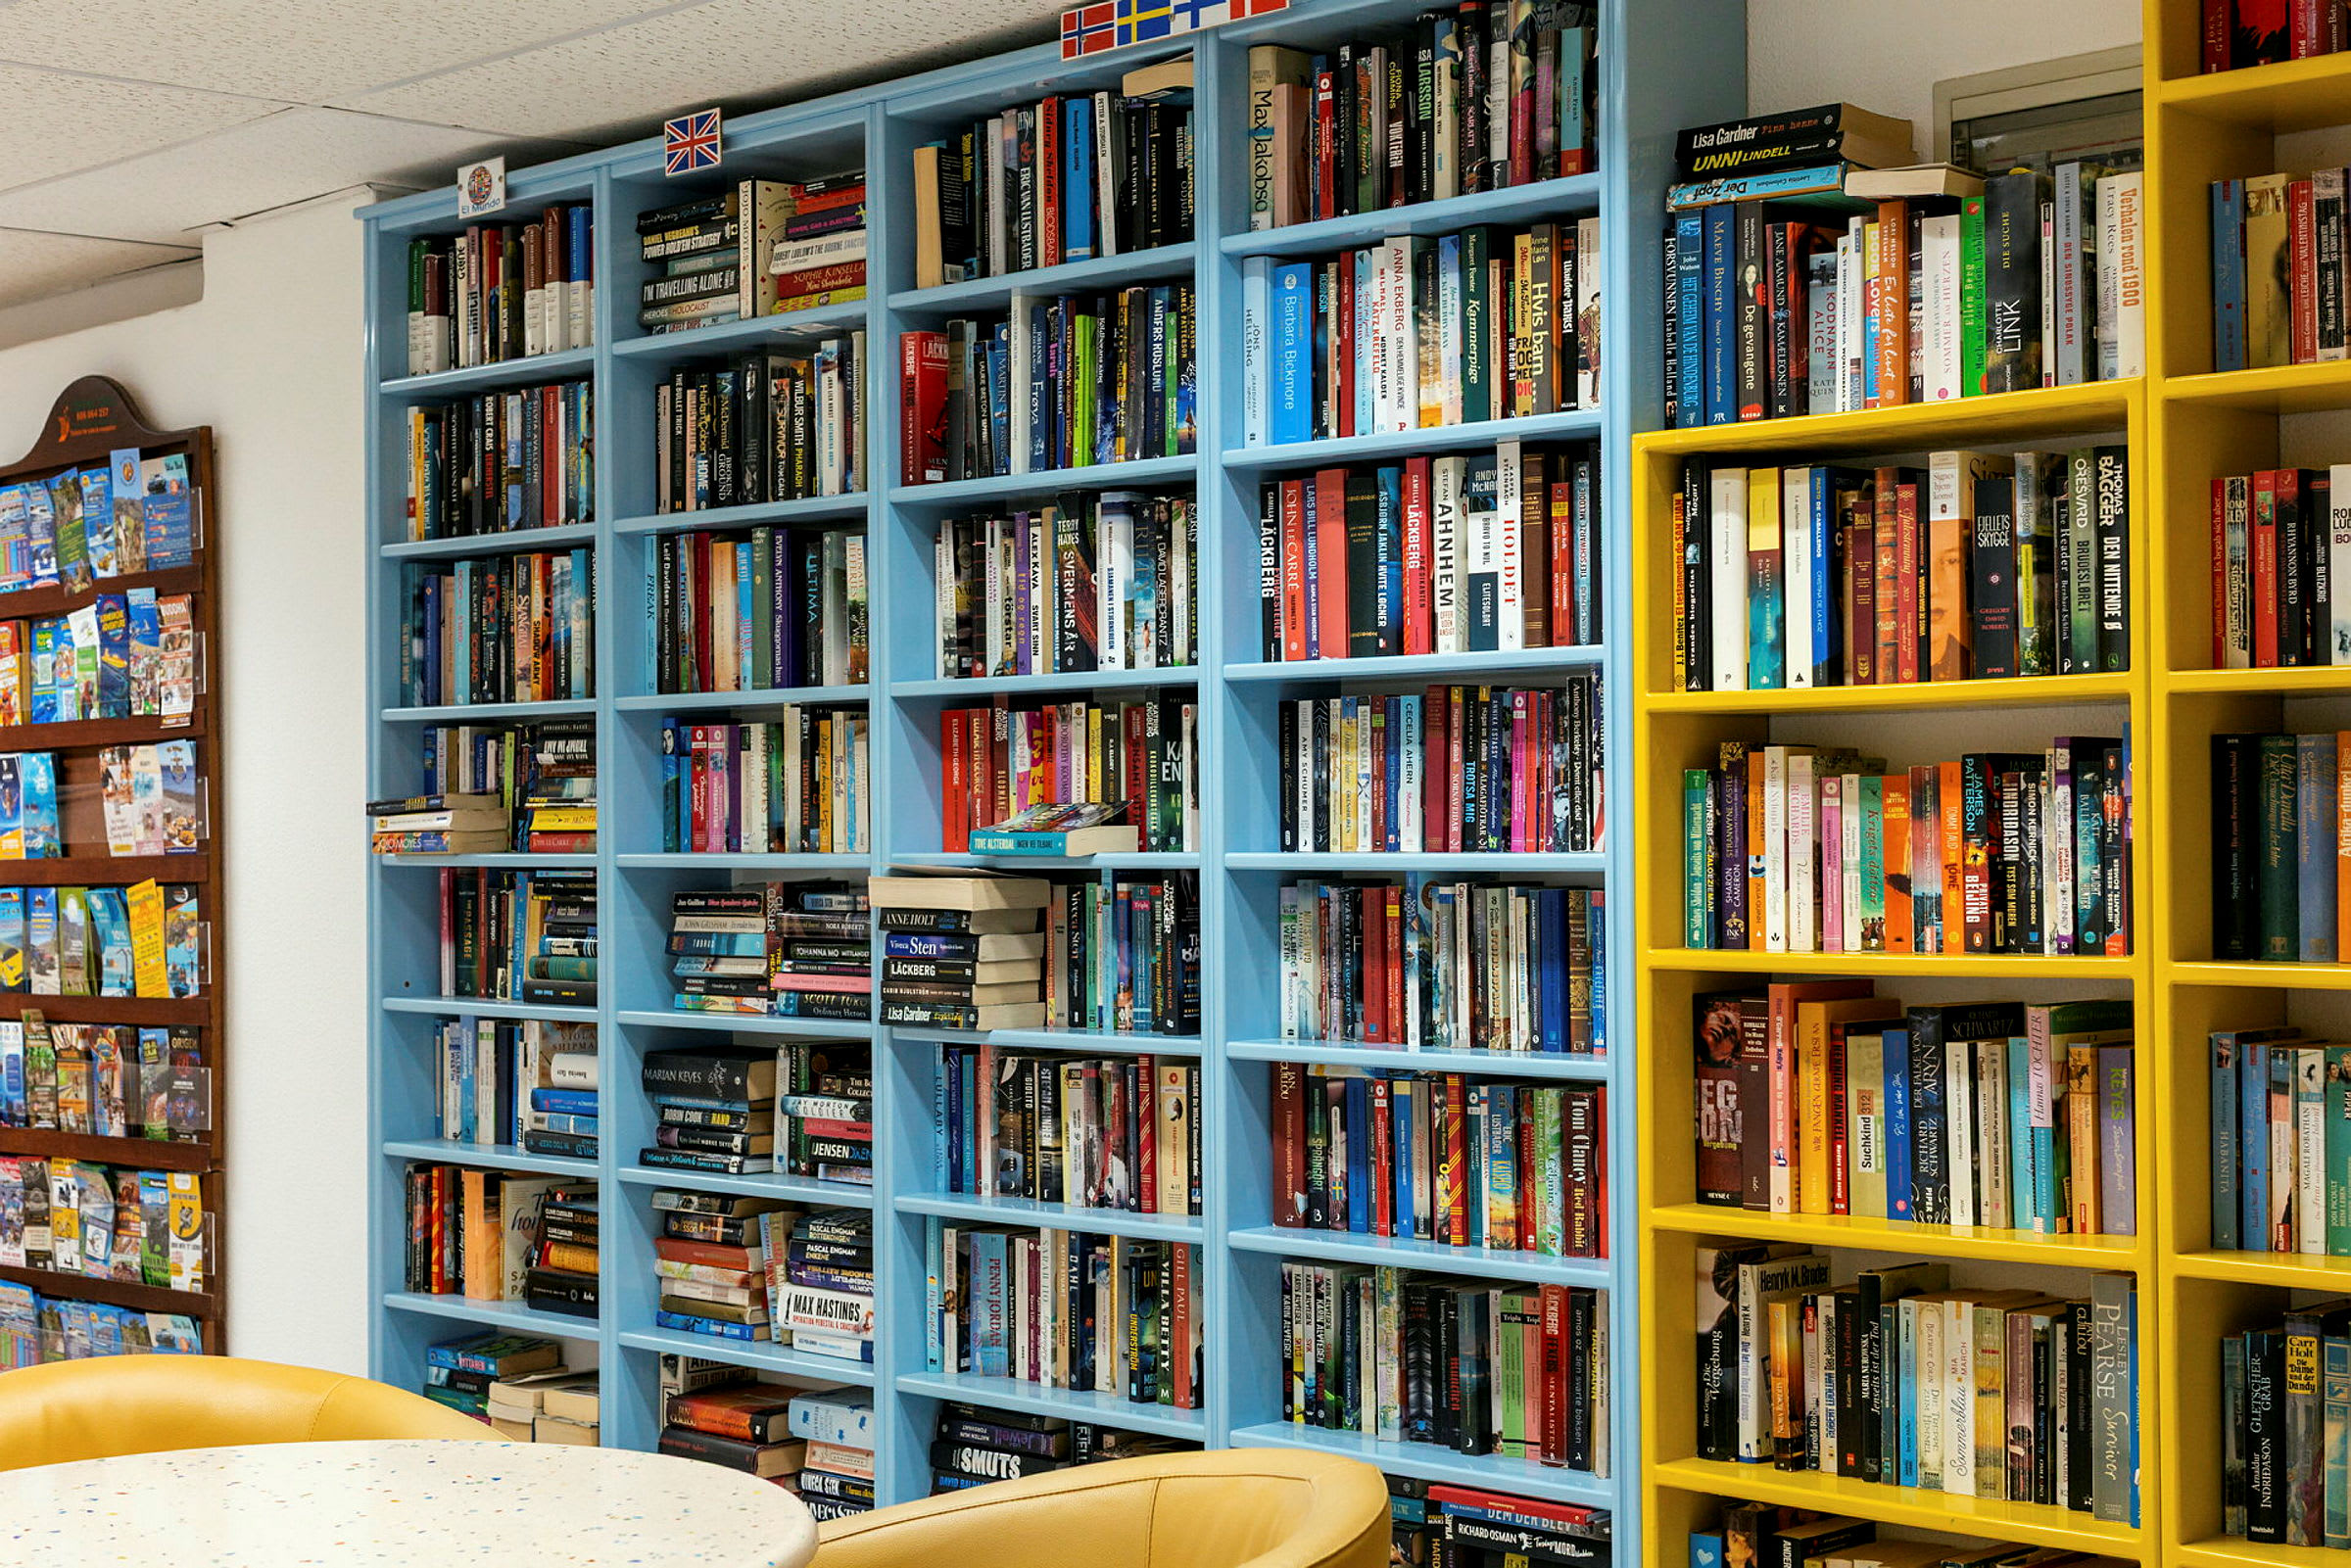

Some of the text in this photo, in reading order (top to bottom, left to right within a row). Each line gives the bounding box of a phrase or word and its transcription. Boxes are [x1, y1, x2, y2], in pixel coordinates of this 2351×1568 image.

[1418, 62, 1432, 120] LARSSON
[1254, 90, 1272, 213] Max Jakobso
[1693, 124, 1758, 149] Lisa Gardner
[1693, 146, 1791, 172] UNNI LINDELL
[470, 198, 501, 213] Mundo
[1693, 181, 1748, 201] Der Zopf
[1713, 221, 1725, 312] MAEVE BINCHY
[2001, 211, 2011, 269] DIE SUCHE
[2120, 187, 2140, 308] Verhalen rond 1900
[644, 274, 723, 302] I'M TRAVELLING ALONE
[793, 263, 865, 284] SOPHIE KINSELLA
[1394, 248, 1405, 332] ANNA EKBERG
[1774, 231, 1787, 306] JANE AAMUND
[1532, 282, 1549, 377] Hvis barn
[1664, 238, 1677, 397] FORSVUNNEN Isabelle Holland
[1826, 293, 1837, 370] KODNAMN
[1869, 278, 1883, 332] Lovers
[2002, 299, 2022, 353] LINK
[1285, 296, 1297, 410] Barbara Bickmore
[1466, 299, 1481, 384] Kammerpige
[1743, 306, 1756, 390] De gevangene
[1814, 309, 1825, 355] ALICE
[1776, 322, 1788, 397] KAMÆLEONEN
[795, 380, 804, 415] WILBUR
[794, 417, 804, 446] SMITH
[698, 459, 708, 491] HOME
[2113, 462, 2124, 515] THOMAS
[1057, 518, 1080, 533] TERRY
[1058, 532, 1080, 546] HAYES
[1285, 489, 1300, 593] JOHN LE CARRÉ
[1306, 485, 1318, 580] LARS BILL LUNDHOLM
[1407, 503, 1422, 570] LÄCKBERG
[1675, 499, 1684, 541] SAN JUAN
[1978, 514, 2010, 533] FJELLETS
[1978, 531, 2010, 547] SKYGGE
[2059, 506, 2071, 572] The Reader
[2098, 455, 2123, 631] BAGGER DEN NITTENDE Ø
[1261, 518, 1276, 598] LÄCKBERG
[1437, 502, 1454, 608] AHNHEM
[1504, 519, 1516, 608] HOLDET
[2077, 540, 2090, 613] BRUDESLØRET
[2286, 522, 2299, 605] RHYANNON BYRD
[806, 555, 818, 624] ULTIMA
[1063, 550, 1079, 652] SVERMENS ÅR
[1405, 749, 1414, 784] AHERN
[1964, 758, 1976, 832] PATTERSON
[1974, 773, 1984, 817] JAMES
[1865, 809, 1881, 857] Krigets
[2027, 783, 2038, 863] SIMON KERNICK
[883, 913, 936, 927] ANNE HOLT
[1964, 875, 1981, 924] BEIJING
[1979, 882, 1989, 915] PRIVATE
[891, 962, 936, 976] LÄCKBERG
[909, 936, 936, 955] Sten
[804, 994, 838, 1006] SCOTT
[888, 1007, 932, 1022] Lisa Gardner
[644, 1068, 701, 1084] MARIAN KEYES
[1833, 1045, 1845, 1140] HENNING MANKELL
[1922, 1044, 1942, 1095] ARYN
[2111, 1068, 2124, 1120] KEYES
[813, 1142, 850, 1160] JENSEN
[1861, 1095, 1872, 1168] Suchkind 312
[1919, 1120, 1928, 1173] RICHARD
[1929, 1117, 1938, 1177] SCHWARTZ
[1493, 1161, 1511, 1191] KAISHO
[1568, 1097, 1590, 1249] Tom Clancy Red Rabbit
[1070, 1255, 1079, 1292] DAHL
[1760, 1263, 1829, 1293] Henryk M. Broder
[793, 1295, 861, 1322] MAX HASTINGS
[989, 1258, 1002, 1347] PENNY JORDAN
[1160, 1260, 1171, 1372] VILLA BETTY
[1176, 1285, 1186, 1321] PAUL
[2077, 1307, 2087, 1354] GUILLOU
[2117, 1326, 2127, 1377] LESLEY
[2096, 1303, 2128, 1480] PEARSE Survivor
[2250, 1353, 2262, 1433] GLETSCHER-
[2261, 1377, 2272, 1410] GRAB
[1950, 1384, 1968, 1476] Sommerblau
[960, 1447, 1021, 1480] SMUTS
[2261, 1438, 2272, 1508] INDRIÐASON
[1458, 1523, 1517, 1544] RICHARD OSMAN
